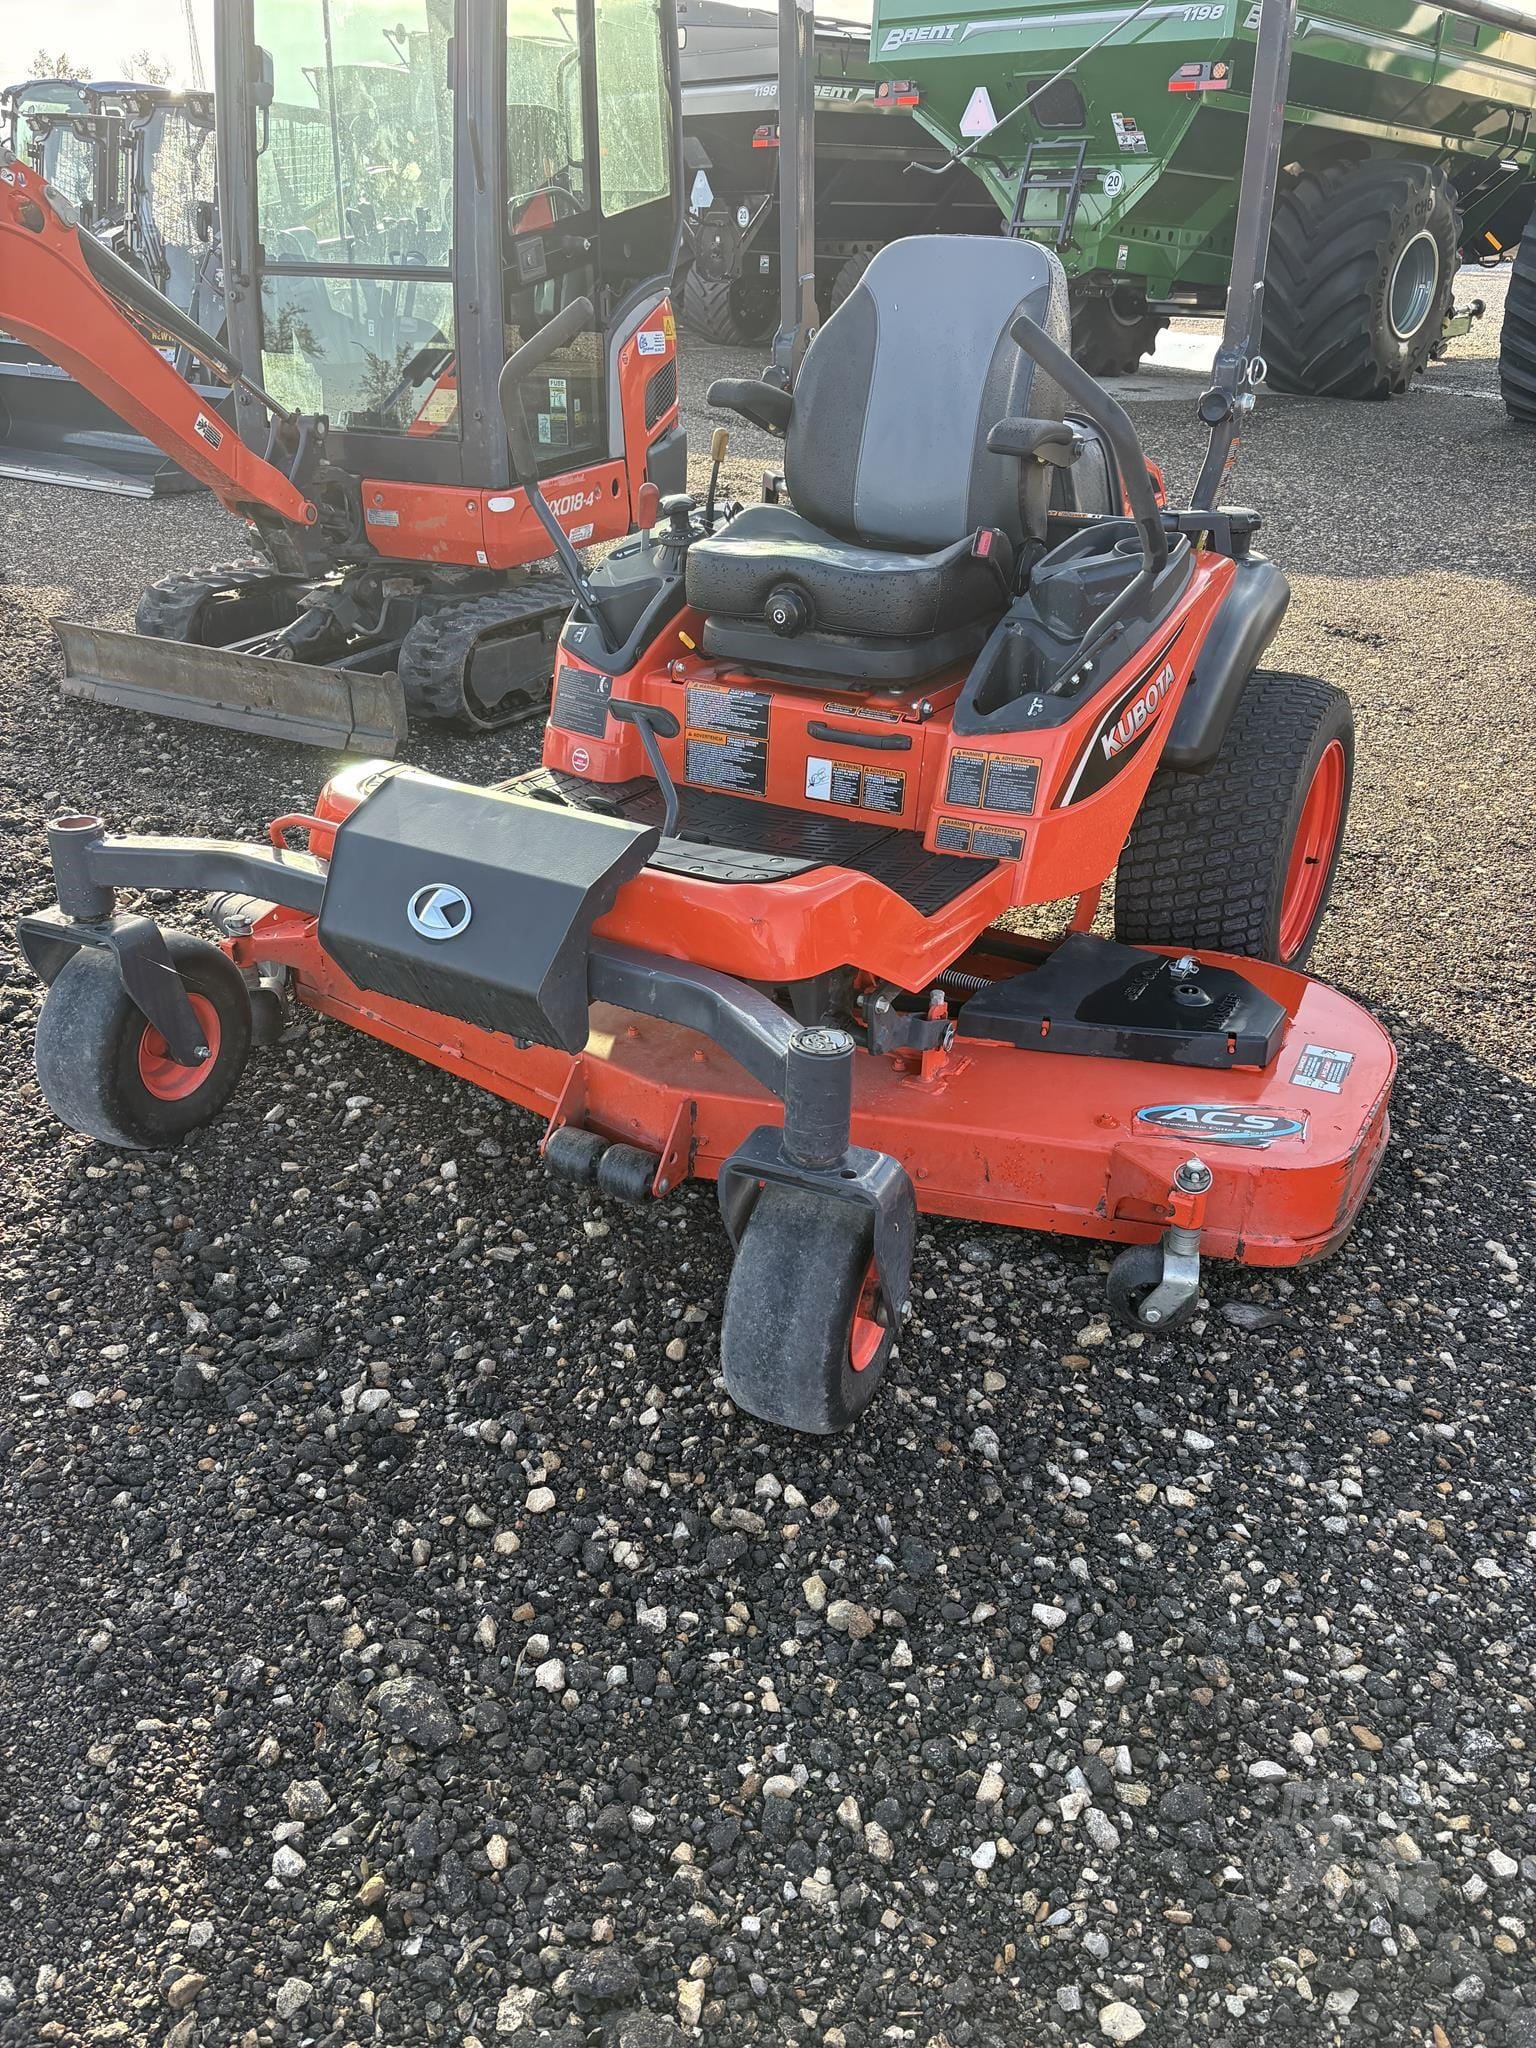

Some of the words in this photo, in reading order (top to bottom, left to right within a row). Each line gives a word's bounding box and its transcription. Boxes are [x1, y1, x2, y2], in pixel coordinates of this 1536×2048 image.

[1183, 5, 1225, 21] 1198
[880, 24, 960, 51] BRENT
[754, 85, 777, 97] 1198
[813, 85, 854, 99] RENT
[1107, 175, 1120, 187] 20
[1101, 662, 1175, 760] KUBOTA
[984, 826, 1020, 836] ADVERTENCIA
[1160, 1107, 1279, 1130] ACS
